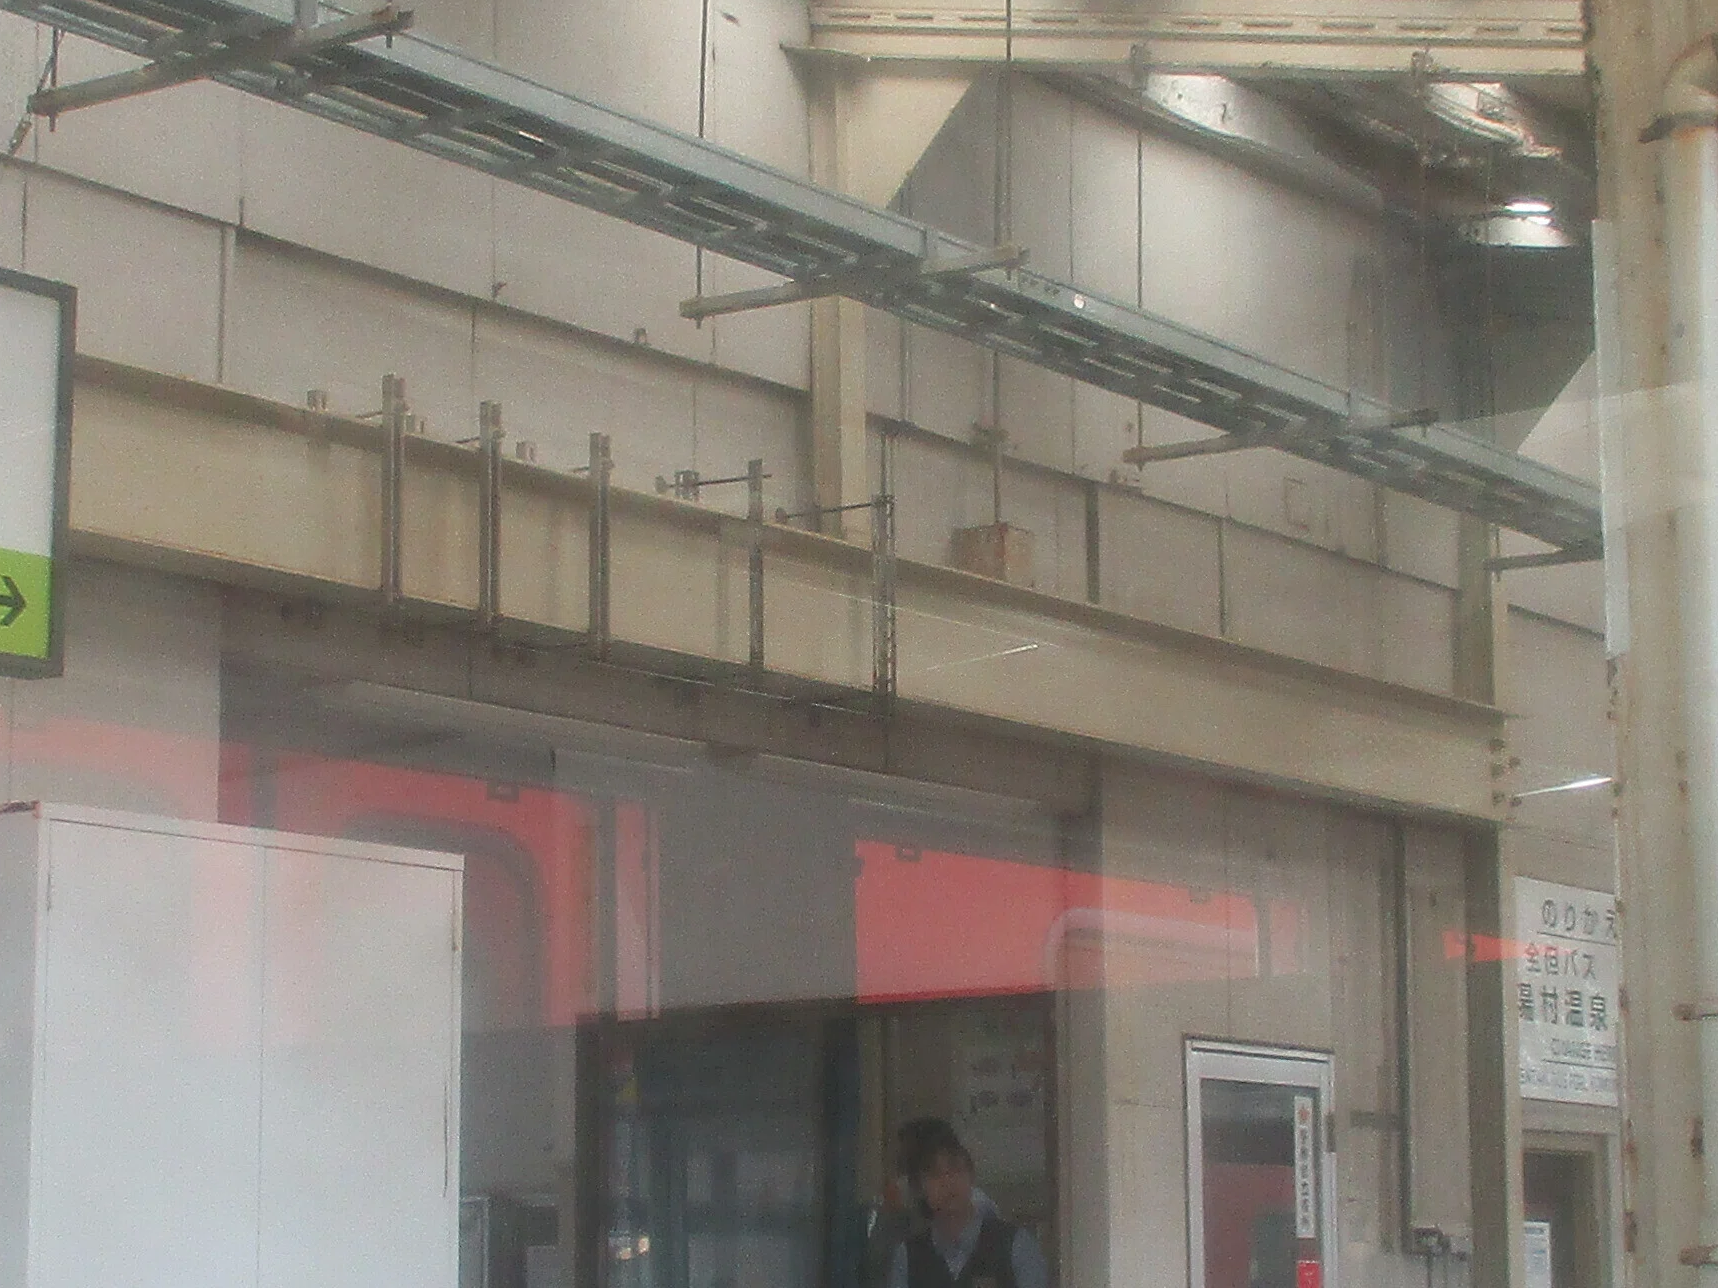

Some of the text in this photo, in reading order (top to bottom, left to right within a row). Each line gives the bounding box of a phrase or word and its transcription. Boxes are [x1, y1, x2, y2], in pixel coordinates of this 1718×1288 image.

[1541, 898, 1616, 939] のりかえ
[1524, 942, 1597, 980] 全但バス
